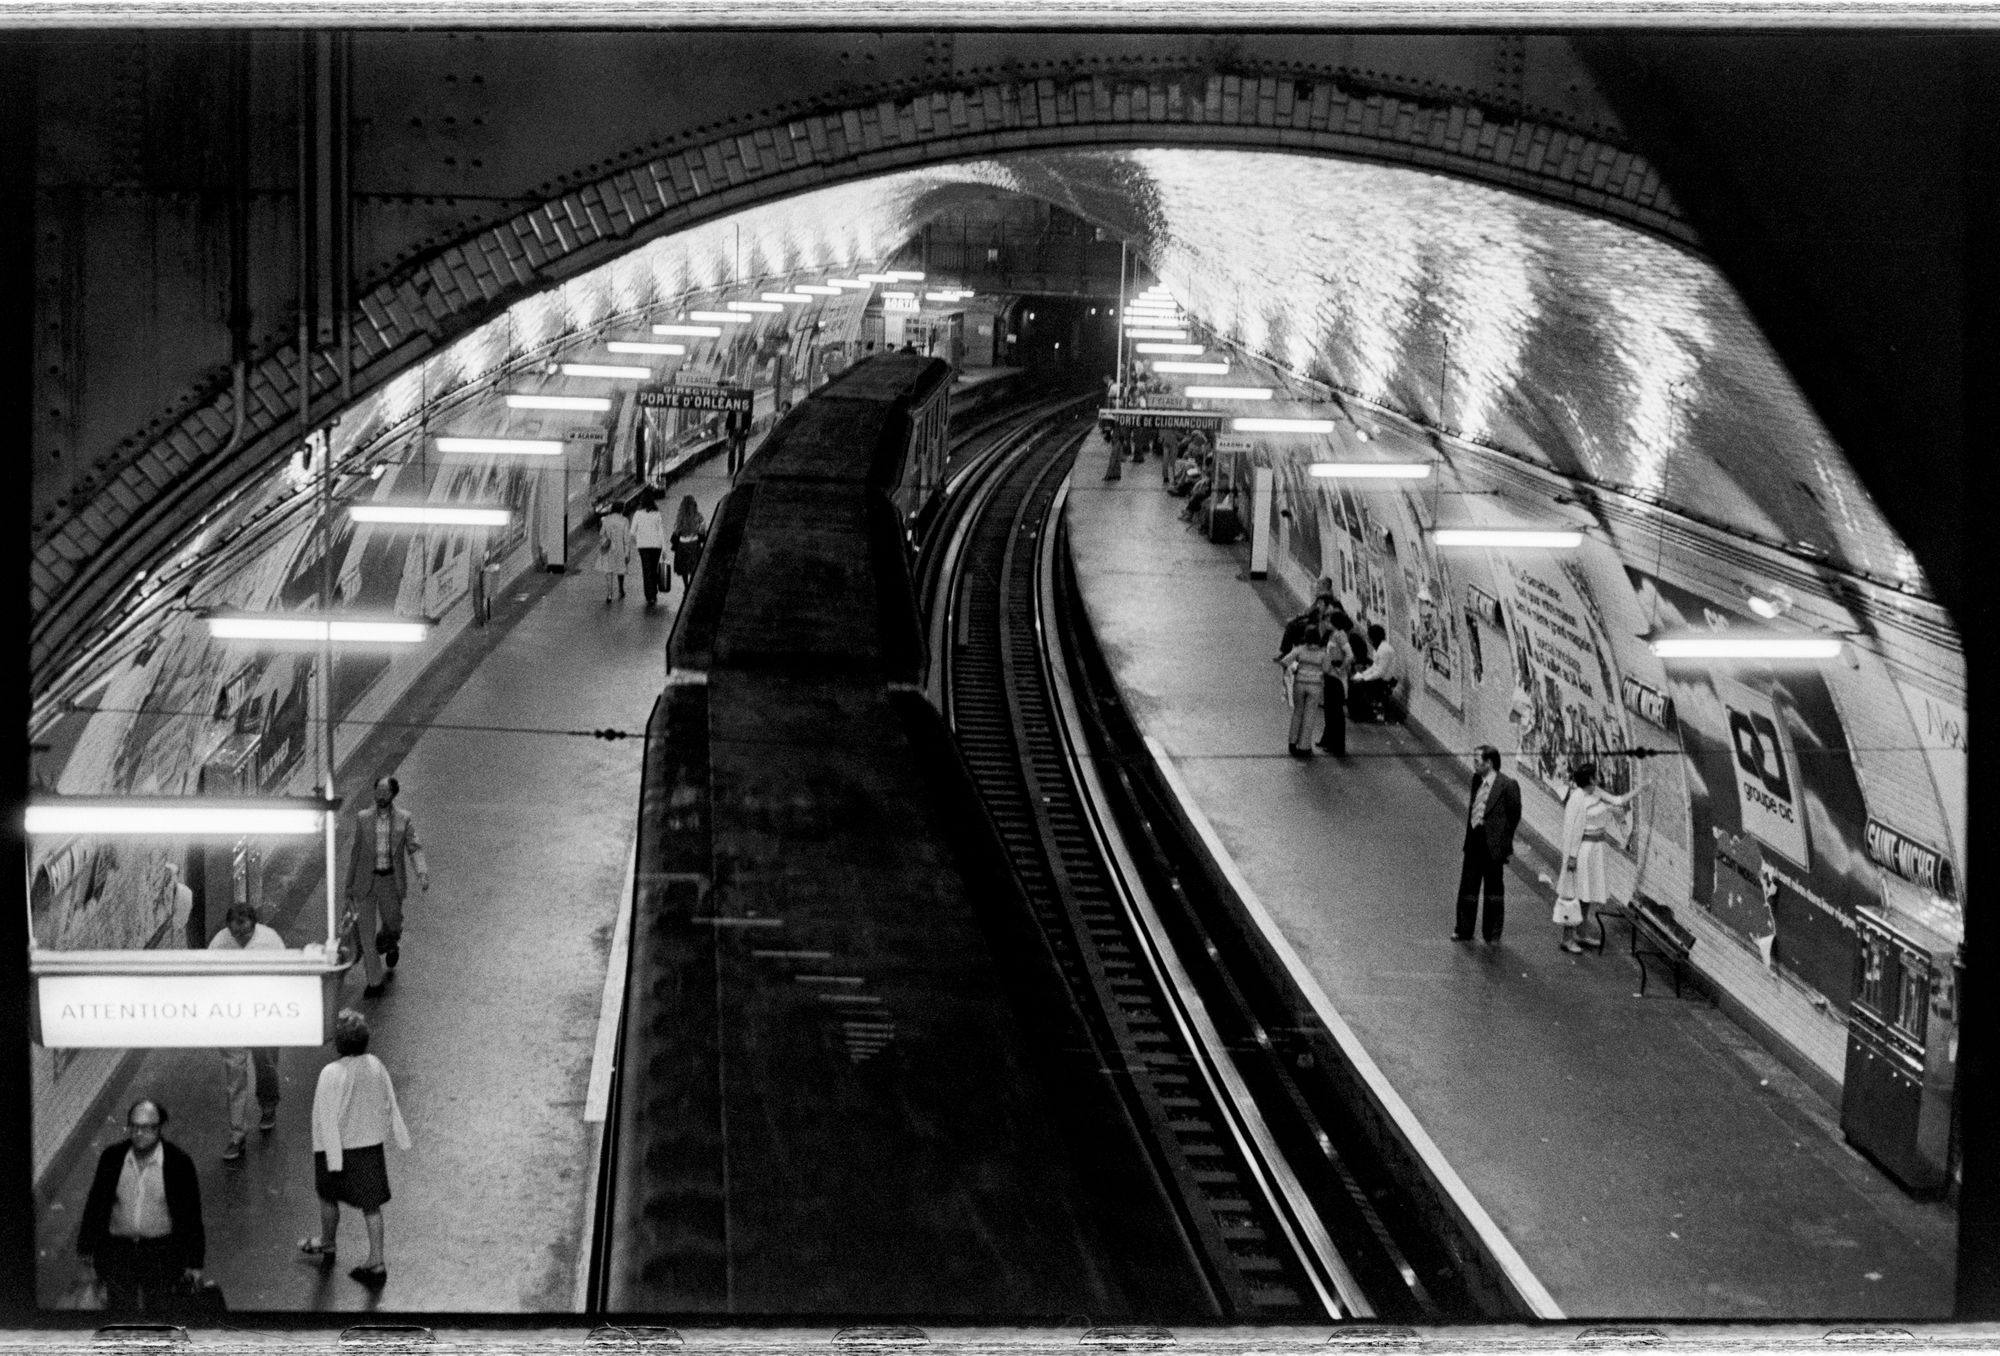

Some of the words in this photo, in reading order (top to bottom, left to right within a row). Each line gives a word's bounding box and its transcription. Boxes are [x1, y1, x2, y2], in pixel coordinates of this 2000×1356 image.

[663, 385, 728, 397] DIRECTION
[640, 392, 679, 406] PORTE
[1155, 416, 1218, 430] CLIGNANCOURT
[1744, 781, 1777, 815] groupe
[61, 1003, 198, 1019] ATTENTION
[208, 1003, 242, 1019] AU
[253, 1002, 301, 1019] PAS
